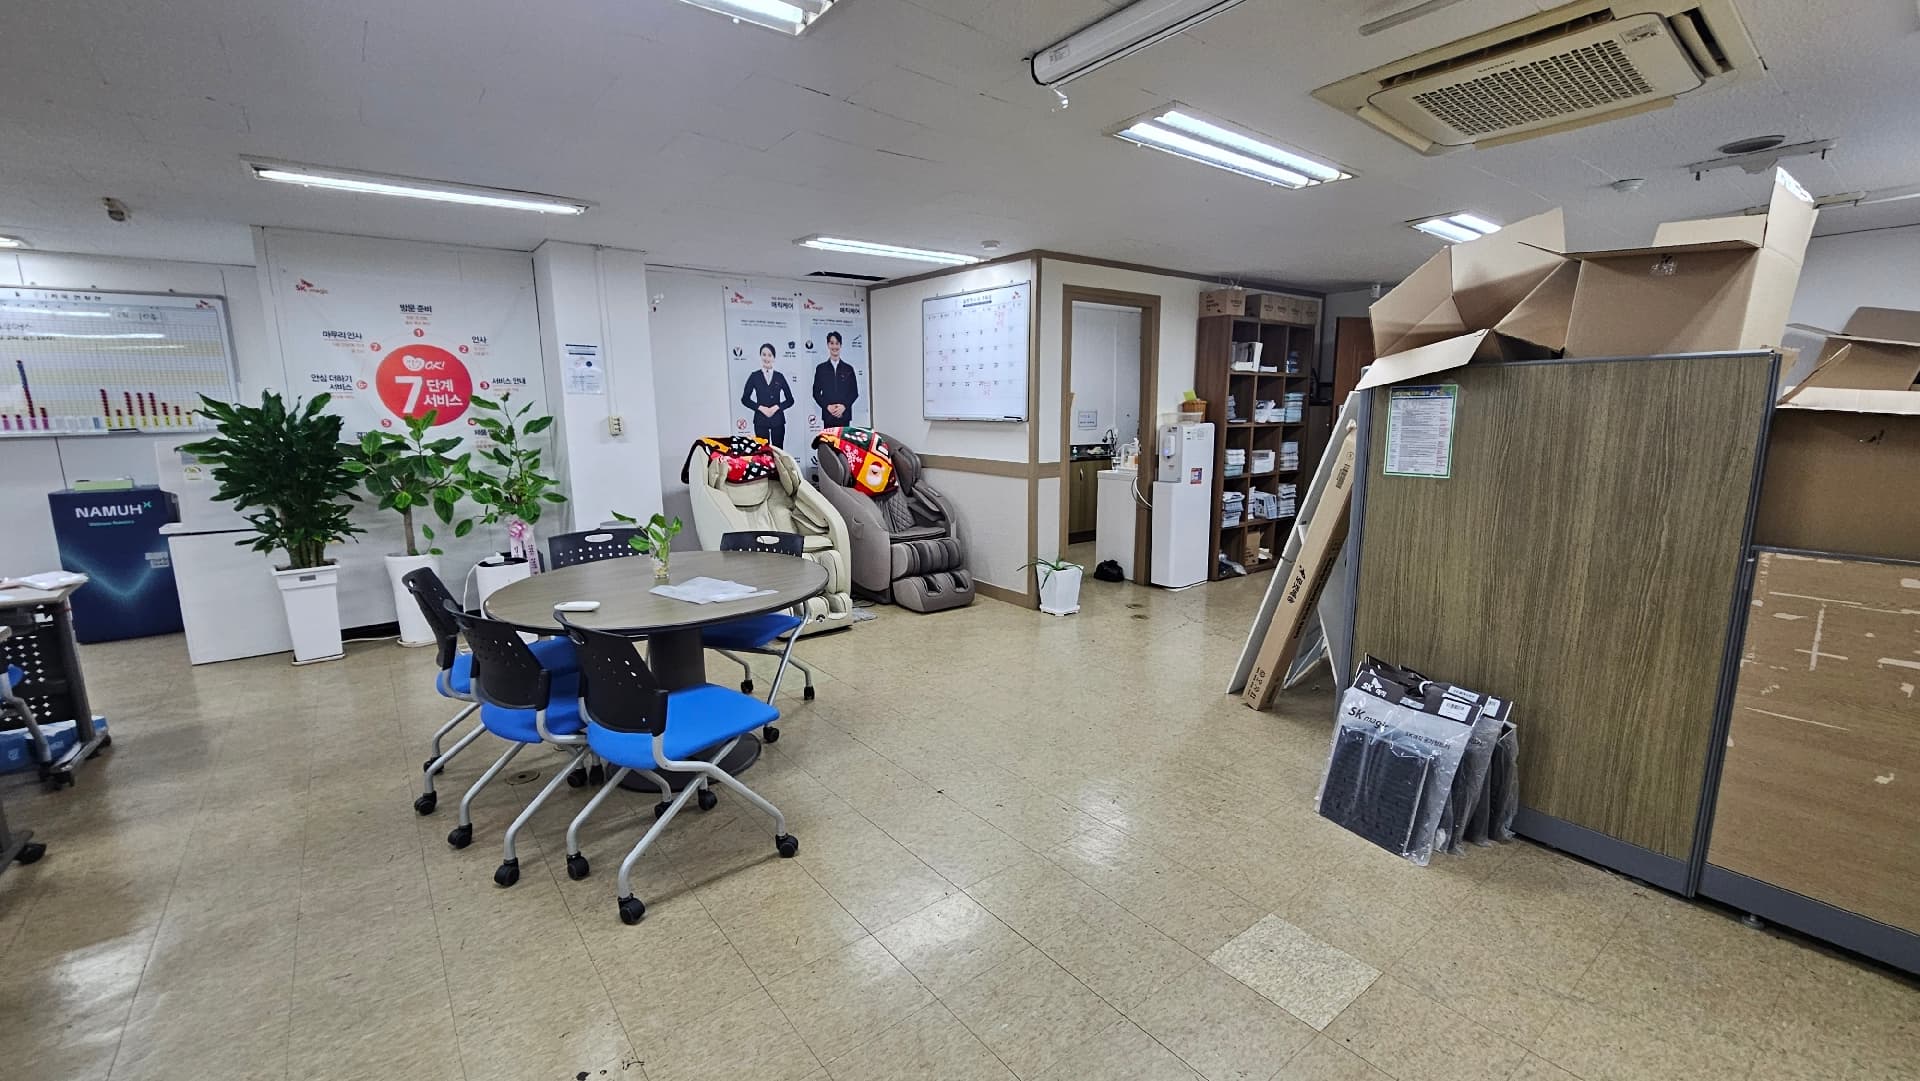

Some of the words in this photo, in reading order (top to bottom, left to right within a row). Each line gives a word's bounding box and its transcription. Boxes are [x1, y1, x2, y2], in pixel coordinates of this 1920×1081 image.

[400, 304, 415, 313] 방문
[417, 304, 432, 313] 준비
[322, 330, 346, 339] 마무리
[347, 331, 363, 340] 인사
[472, 336, 487, 344] 인사
[426, 378, 454, 393] 단계
[492, 377, 512, 385] 서비스
[513, 377, 526, 385] 안내
[329, 383, 353, 391] 서비스
[395, 375, 423, 413] 7
[423, 393, 464, 408] 서비스
[1360, 681, 1373, 692] SK
[1348, 706, 1366, 719] SK
